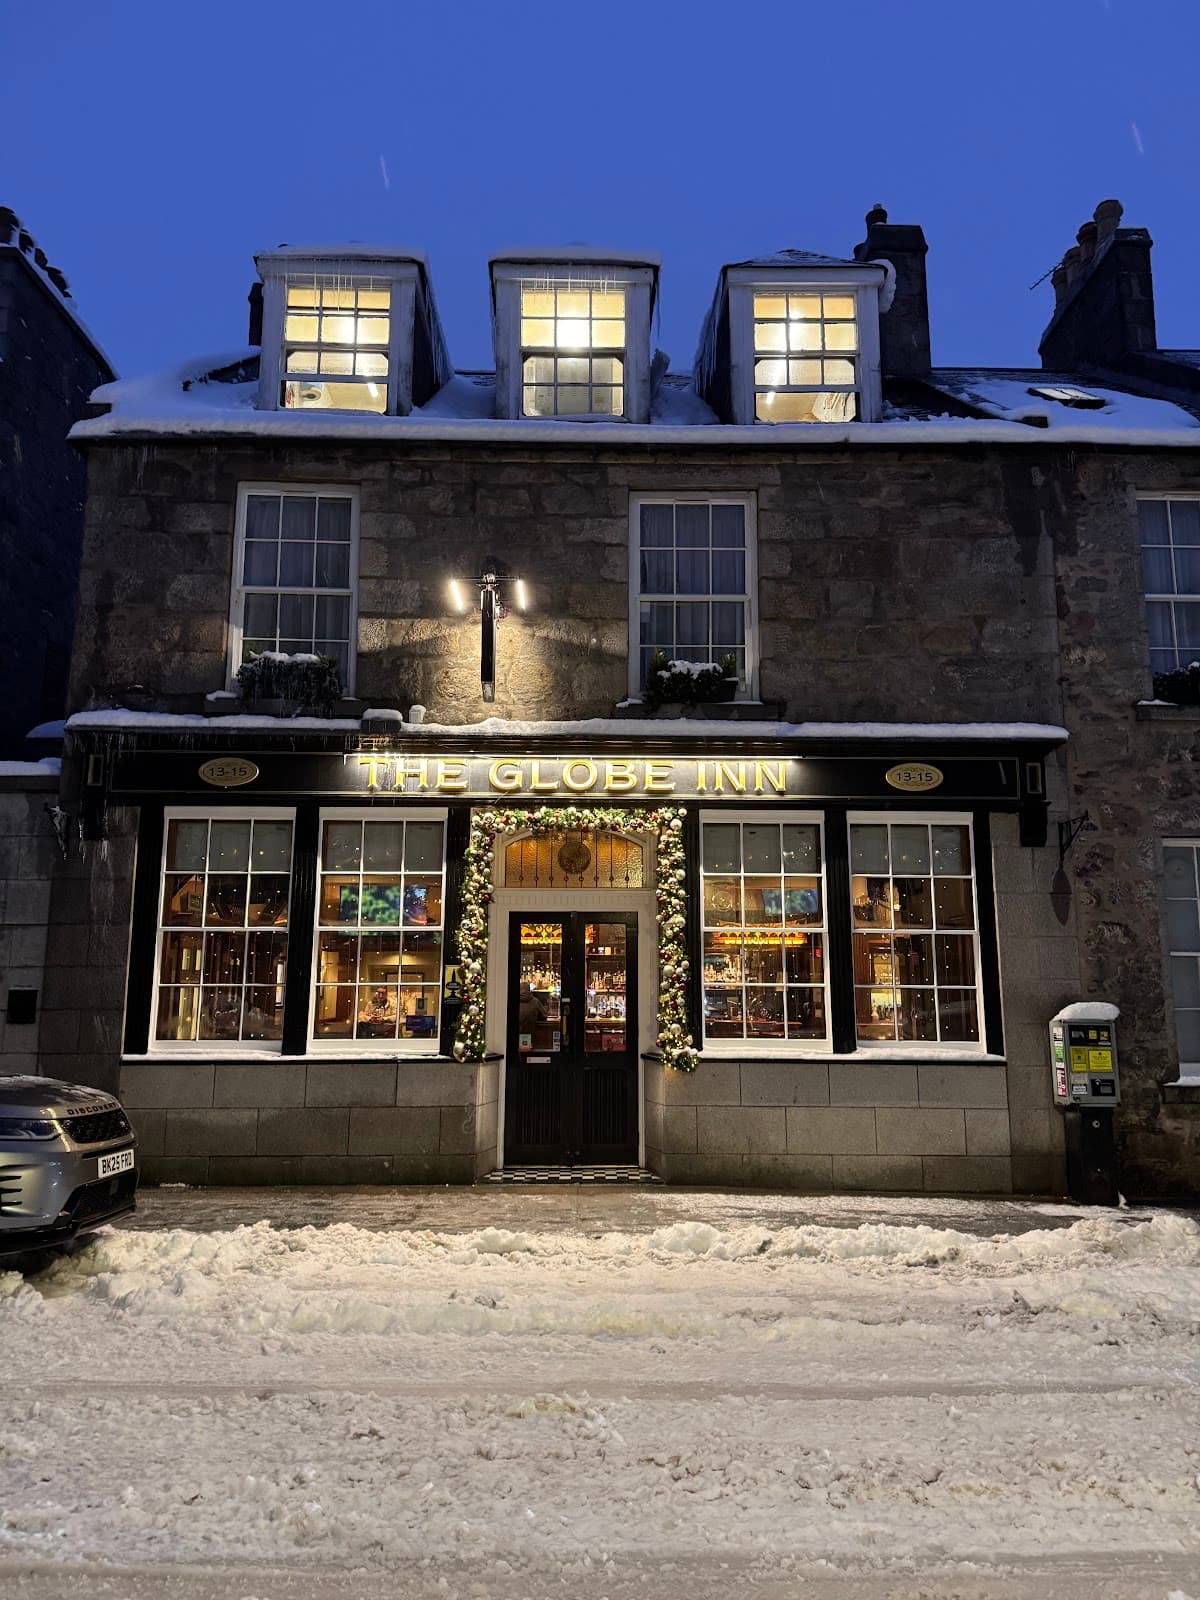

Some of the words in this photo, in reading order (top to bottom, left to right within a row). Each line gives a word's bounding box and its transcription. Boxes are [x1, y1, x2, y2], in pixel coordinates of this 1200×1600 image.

[208, 767, 248, 777] 13-15
[358, 757, 468, 790] THE
[488, 759, 676, 791] GLOBE
[696, 760, 792, 792] INN
[895, 771, 933, 782] 13-15
[102, 1155, 120, 1174] BK25
